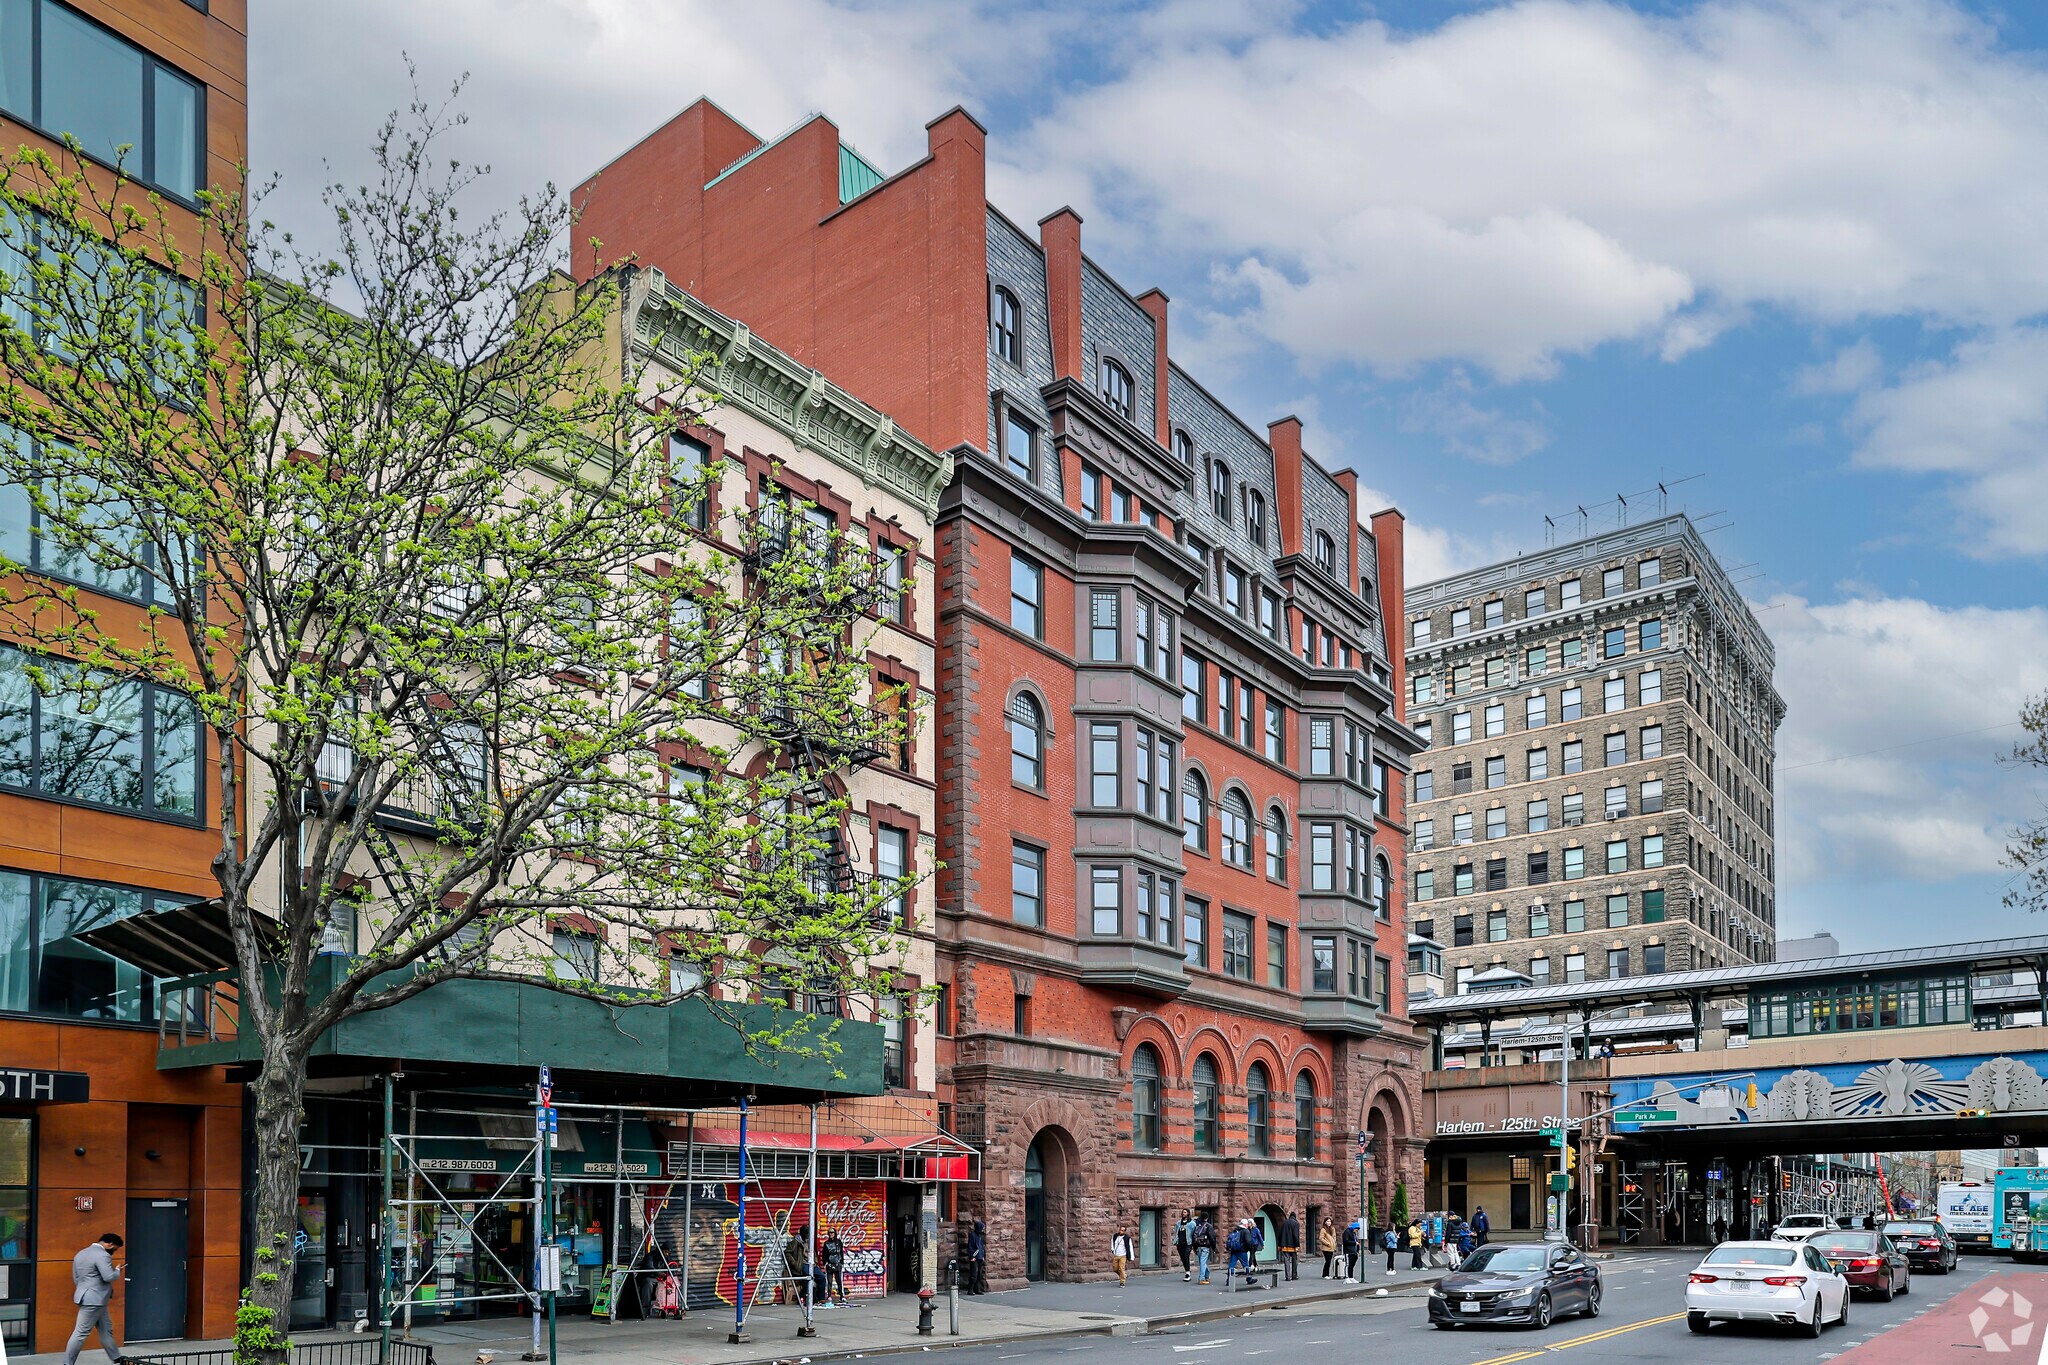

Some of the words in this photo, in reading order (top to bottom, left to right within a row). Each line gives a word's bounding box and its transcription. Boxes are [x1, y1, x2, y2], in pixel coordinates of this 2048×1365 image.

[1435, 1119, 1484, 1134] Harlem
[1500, 1117, 1537, 1131] 125th
[1541, 1115, 1582, 1129] Stree
[431, 1160, 494, 1169] 212.987.6003
[2026, 1174, 2048, 1182] Cryst
